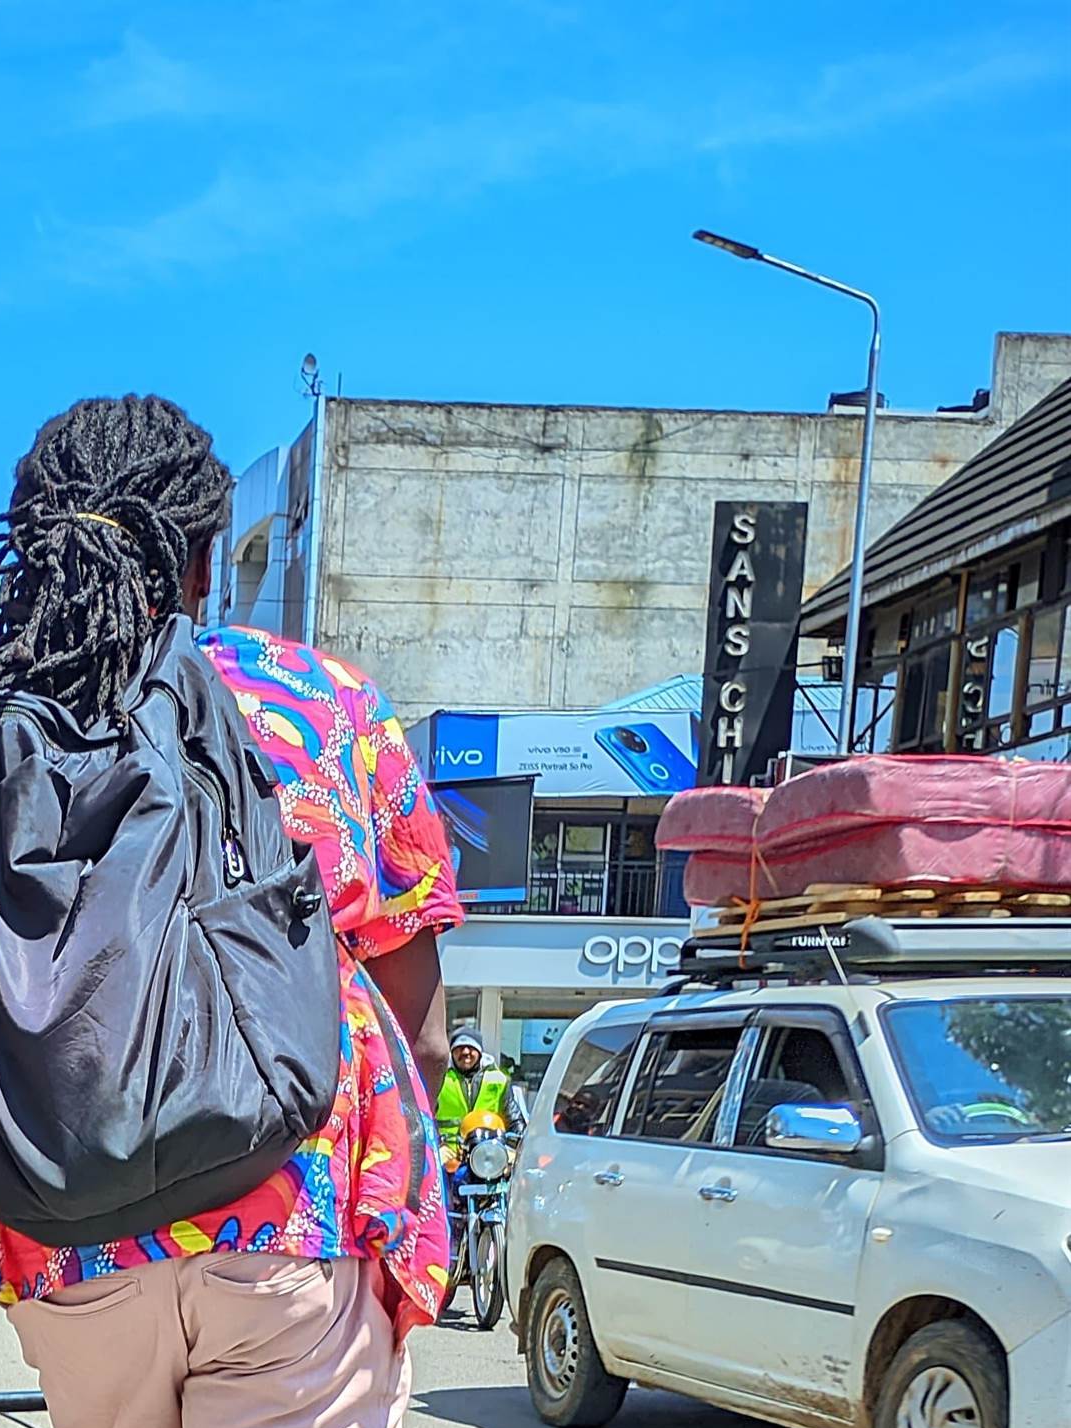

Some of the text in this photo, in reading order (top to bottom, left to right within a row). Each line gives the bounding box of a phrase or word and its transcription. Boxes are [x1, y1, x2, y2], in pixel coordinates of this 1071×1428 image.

[725, 513, 756, 657] SANS
[431, 745, 483, 766] vivo
[528, 746, 551, 754] vivo
[541, 762, 567, 770] Portrait
[580, 762, 593, 770] Pro
[585, 936, 683, 972] opp
